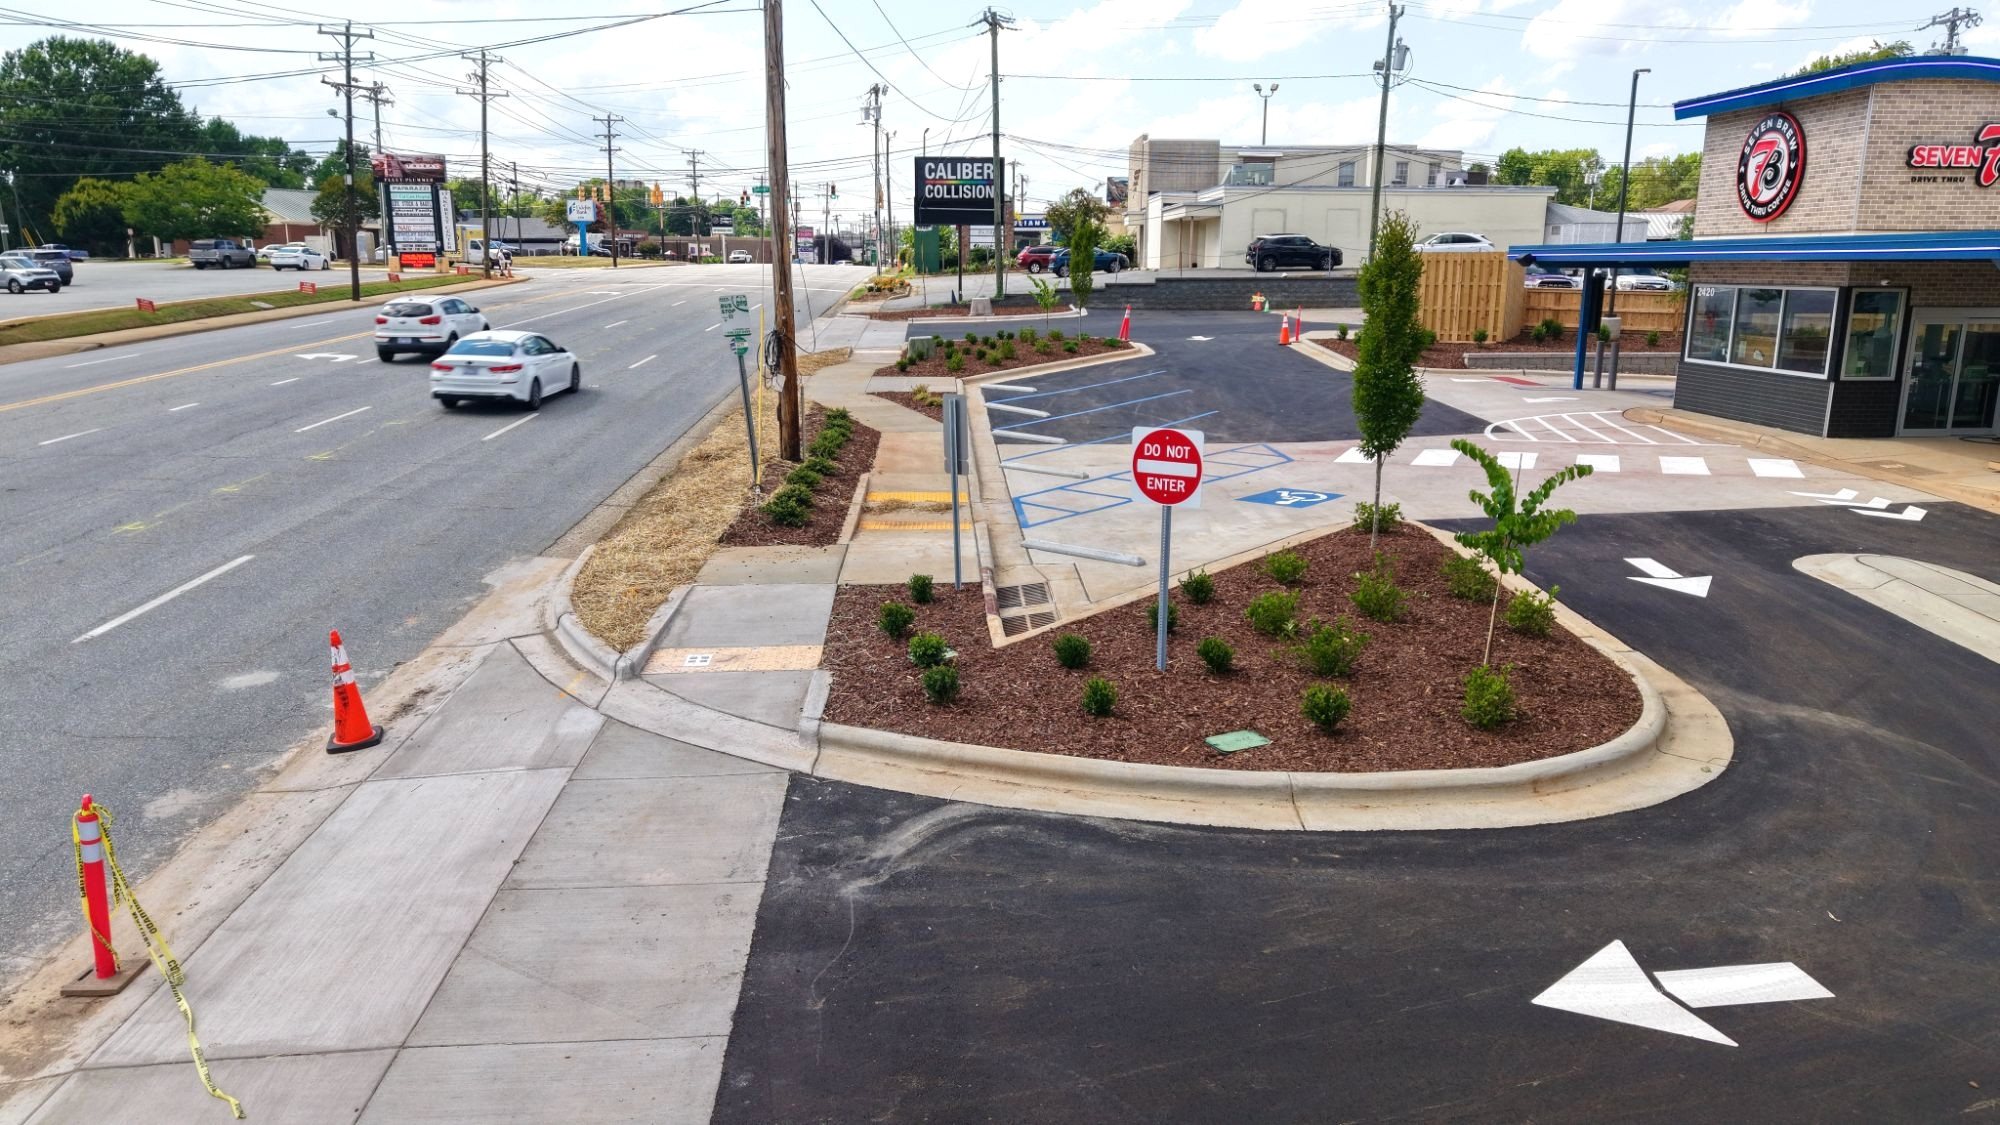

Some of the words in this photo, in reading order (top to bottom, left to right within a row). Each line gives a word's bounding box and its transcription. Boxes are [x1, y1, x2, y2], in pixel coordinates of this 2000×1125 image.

[1744, 118, 1774, 155] SEVEN
[1776, 118, 1798, 150] BREW
[1911, 145, 1983, 167] SEVEN
[924, 162, 994, 180] CALIBER
[924, 184, 995, 199] COLLISION
[1739, 182, 1752, 209] DRIVE
[1750, 204, 1767, 216] THRU
[1767, 180, 1792, 213] COFFEE
[1697, 287, 1715, 297] 2420
[1144, 442, 1161, 457] DO
[1166, 444, 1191, 459] NOT
[1146, 476, 1186, 493] ENTER
